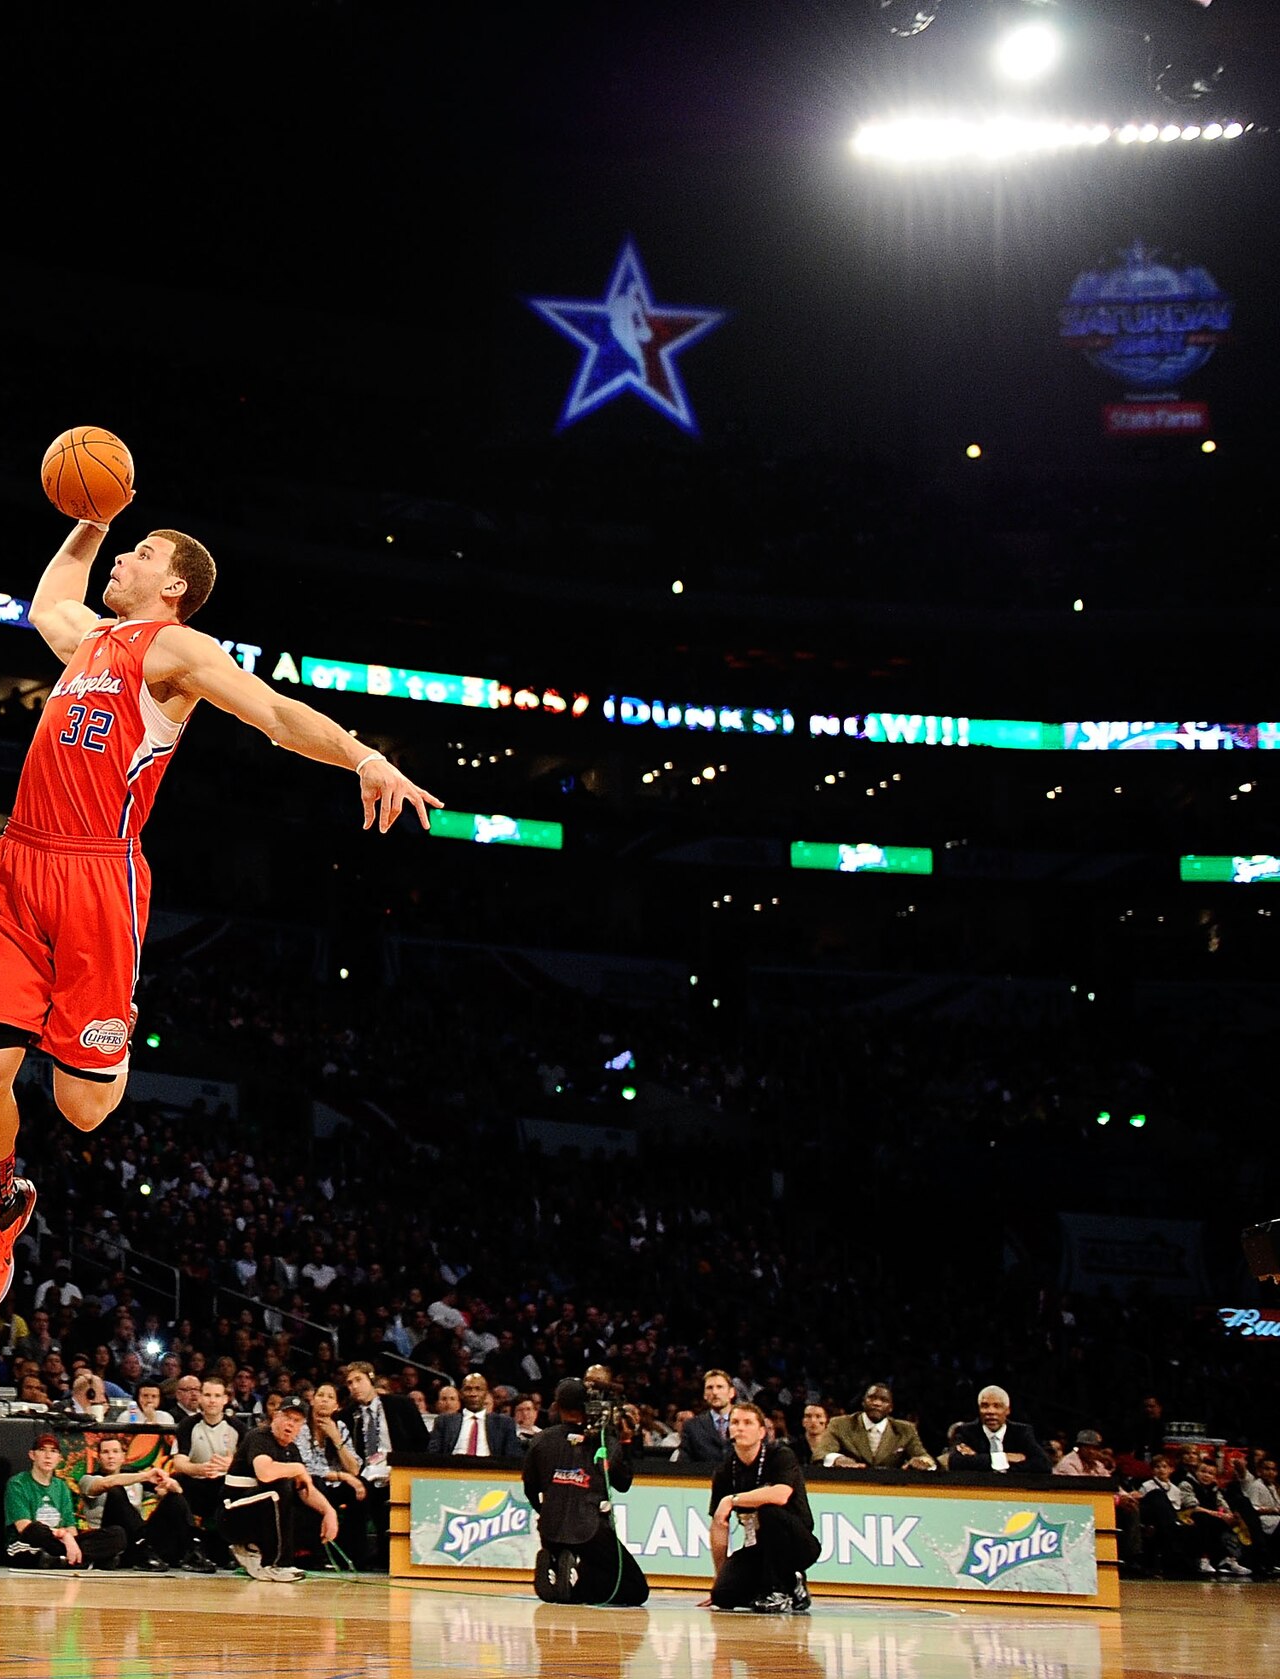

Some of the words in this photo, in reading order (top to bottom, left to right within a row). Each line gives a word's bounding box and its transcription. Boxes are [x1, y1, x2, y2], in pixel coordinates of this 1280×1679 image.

[61, 668, 122, 700] Angeles
[271, 651, 300, 684] A
[367, 664, 391, 695] B
[60, 704, 115, 753] 32
[83, 1029, 123, 1046] CLIPPERS
[443, 1500, 527, 1554] Sprite
[969, 1522, 1059, 1578] Sprite
